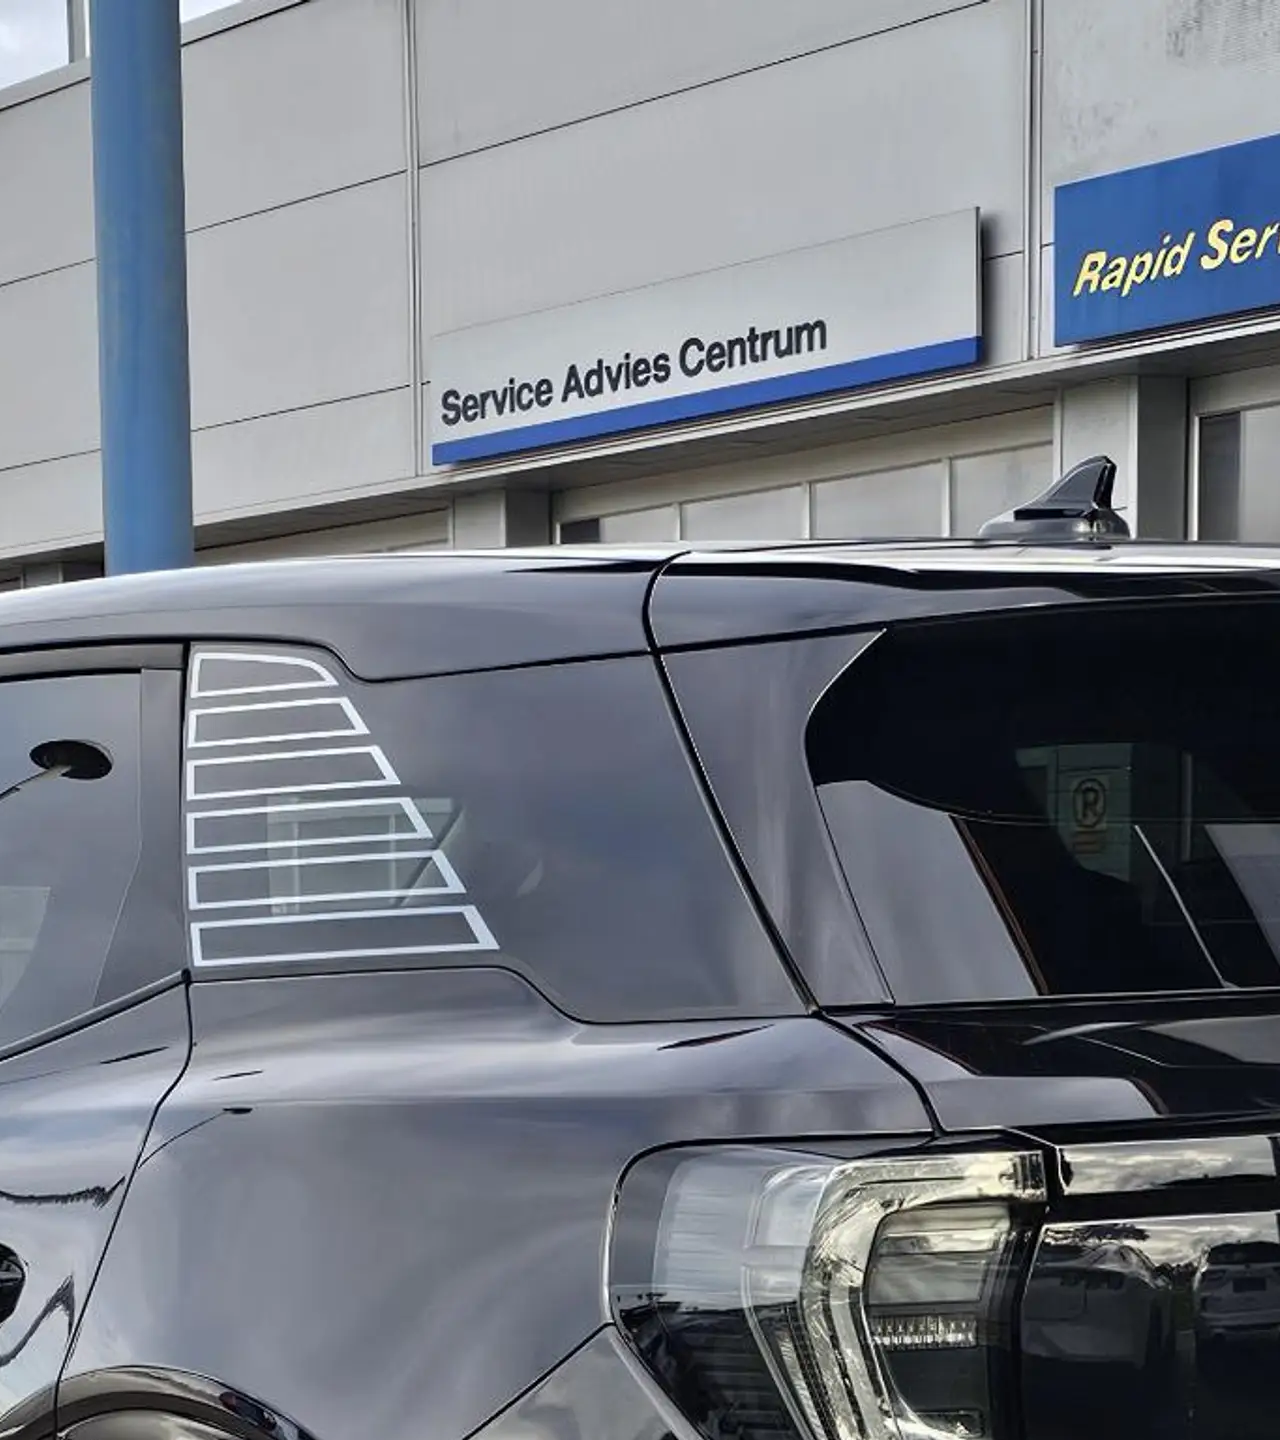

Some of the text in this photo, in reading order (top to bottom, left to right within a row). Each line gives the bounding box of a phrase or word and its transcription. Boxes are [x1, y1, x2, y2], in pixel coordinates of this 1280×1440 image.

[1073, 231, 1196, 297] Rapid
[440, 319, 828, 426] Service Advies Centrum
